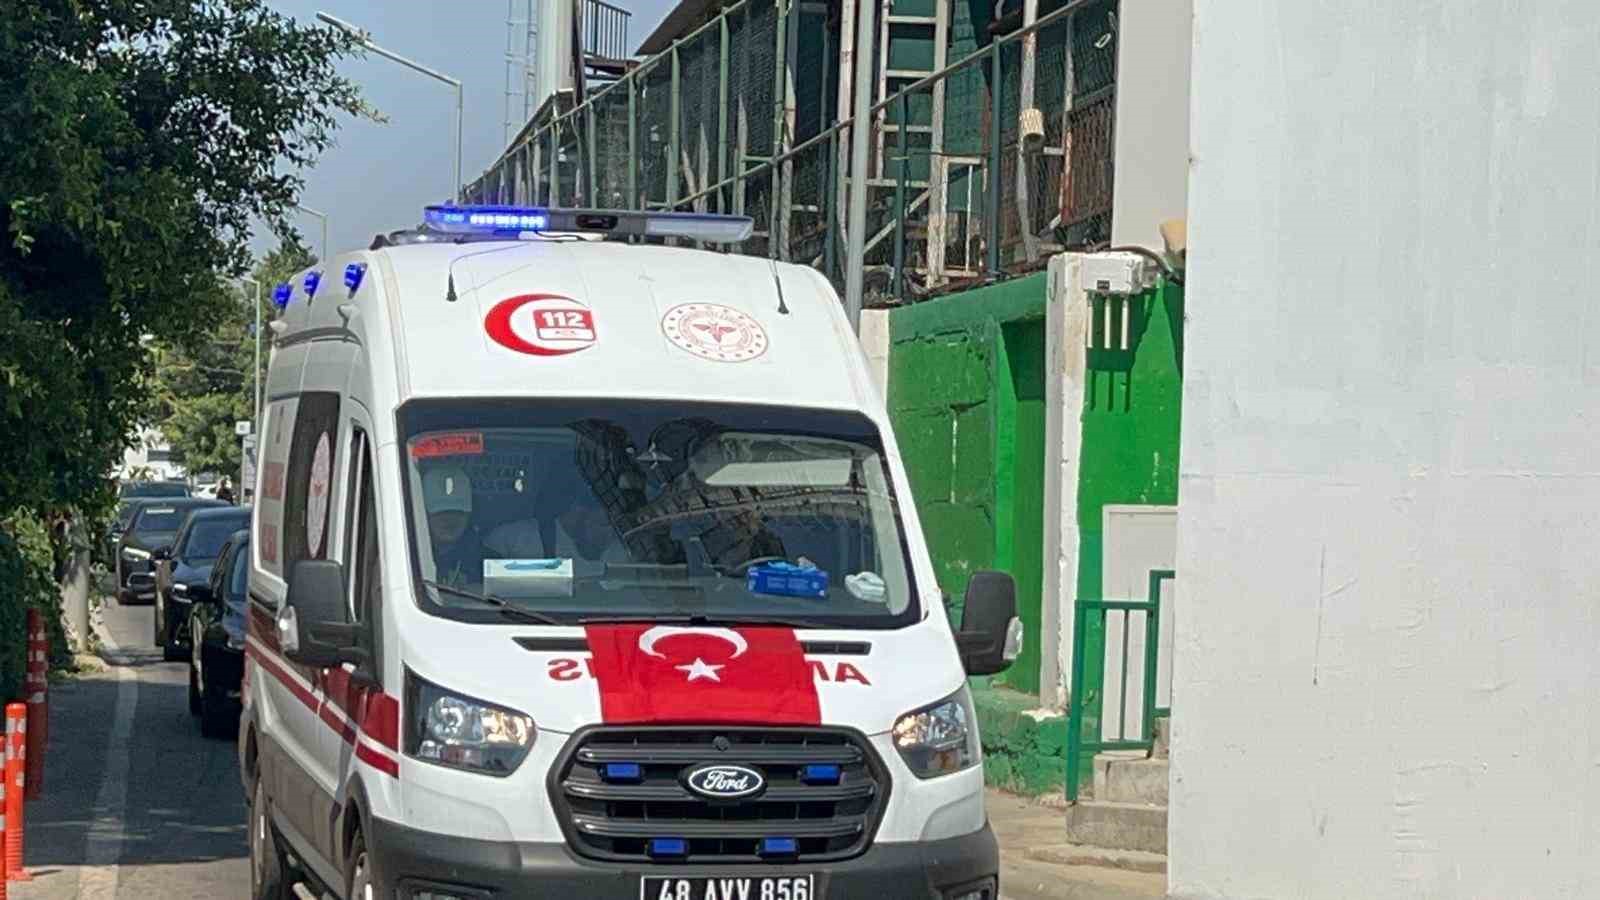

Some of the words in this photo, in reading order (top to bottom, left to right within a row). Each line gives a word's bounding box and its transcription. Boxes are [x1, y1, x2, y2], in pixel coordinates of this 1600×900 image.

[541, 311, 587, 328] 112
[702, 770, 748, 790] Ford
[658, 879, 691, 900] 48
[760, 878, 808, 900] 856
